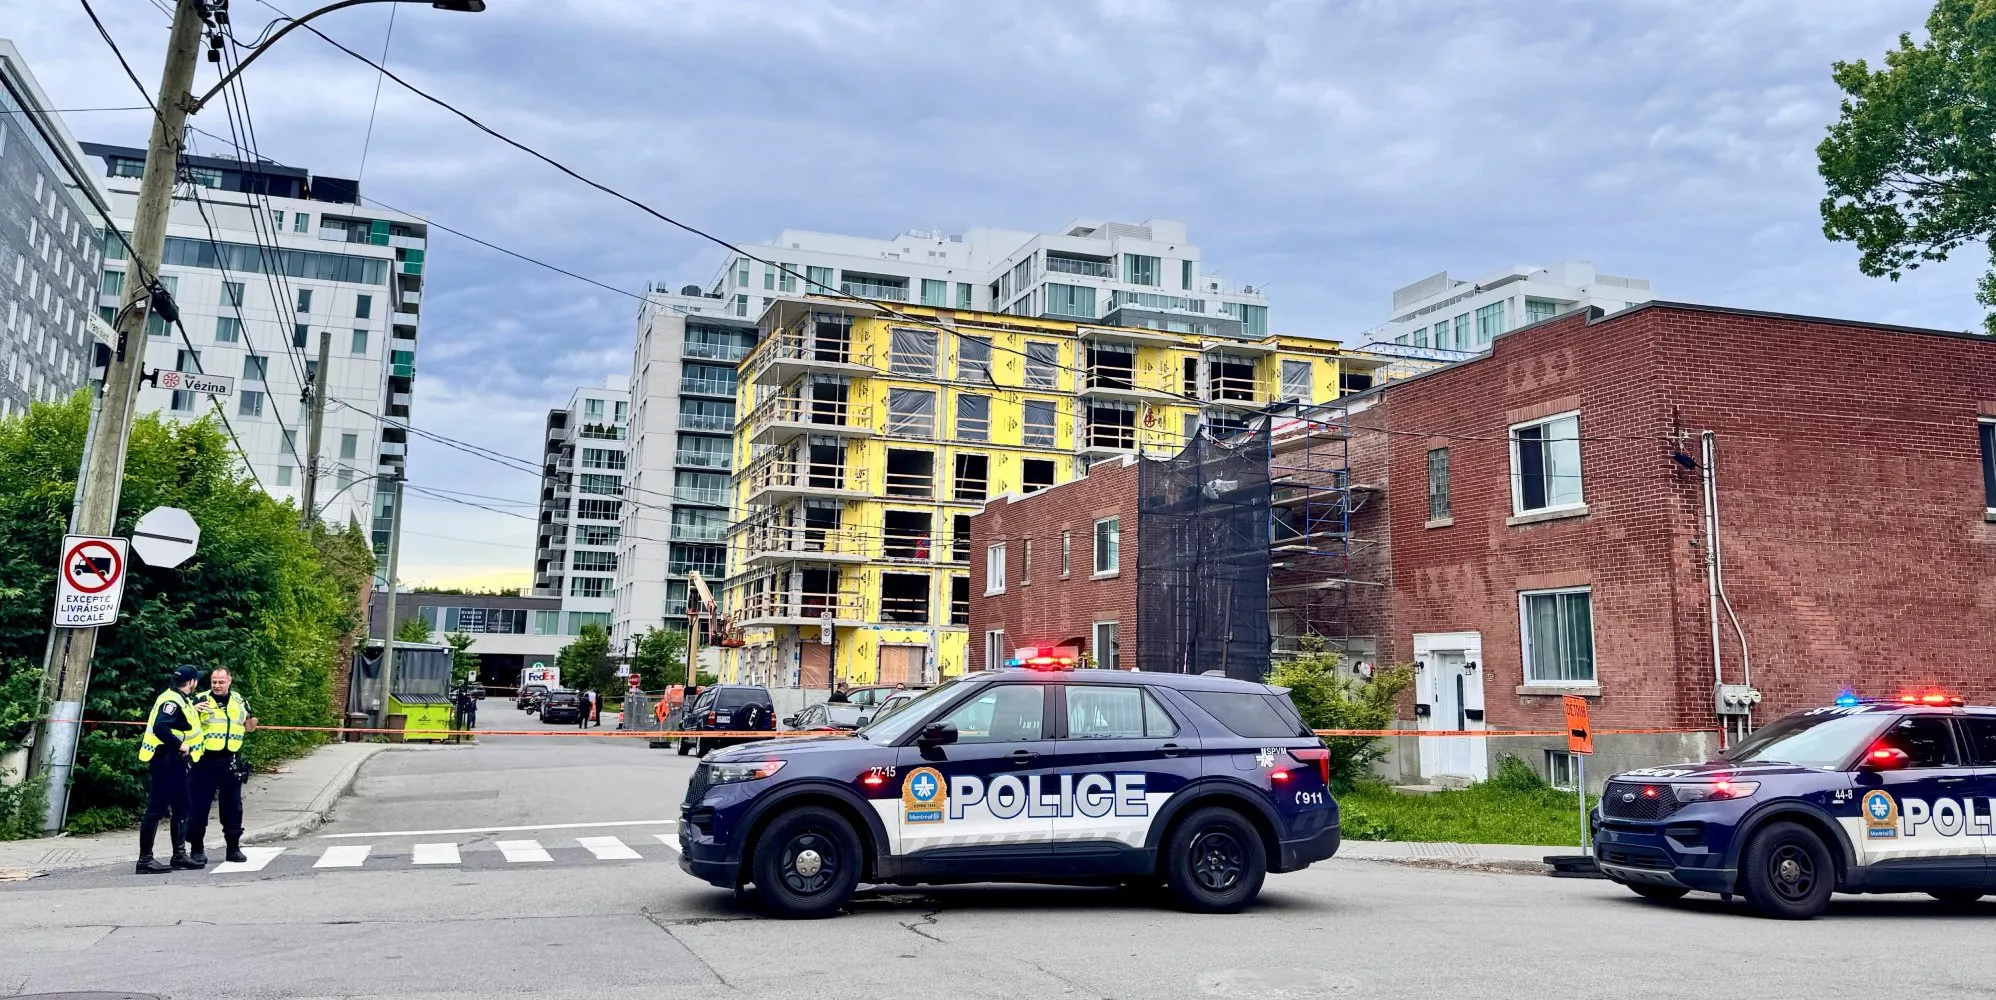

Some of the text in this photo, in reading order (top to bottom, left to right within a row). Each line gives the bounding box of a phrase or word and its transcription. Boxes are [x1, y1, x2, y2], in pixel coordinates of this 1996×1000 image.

[185, 380, 226, 393] Vézina
[66, 594, 111, 603] EXCEPTÉ
[61, 604, 114, 612] LIVRAISON
[67, 613, 104, 622] LOCALE
[528, 672, 556, 681] FedEx
[1266, 747, 1287, 755] SPVM
[870, 766, 896, 777] 27-15
[950, 772, 1149, 820] POLICE
[1302, 792, 1323, 804] 911
[1835, 789, 1853, 799] 44-8
[909, 812, 933, 820] Montréal
[1901, 796, 1996, 837] POLI
